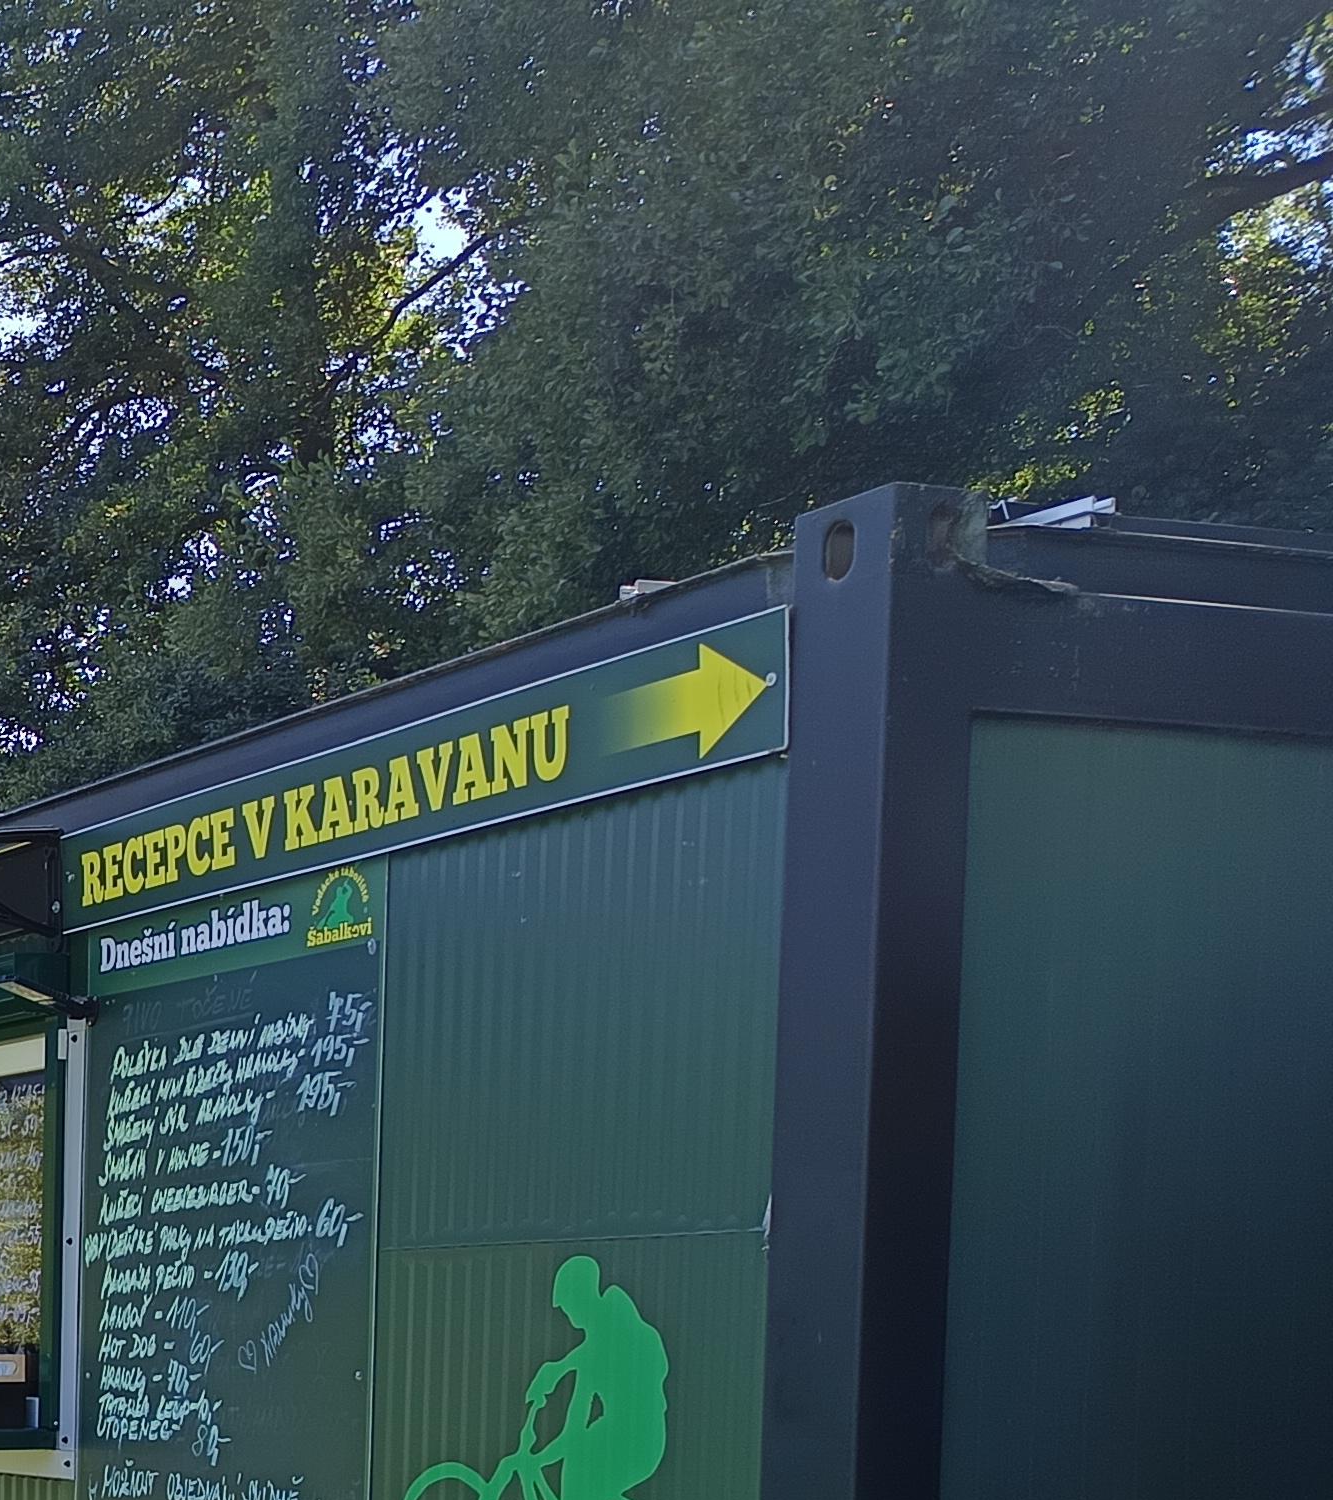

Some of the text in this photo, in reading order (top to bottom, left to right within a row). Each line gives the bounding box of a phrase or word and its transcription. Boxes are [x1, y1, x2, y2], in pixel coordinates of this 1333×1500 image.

[81, 705, 569, 907] RECEPCE V KARAVANU
[100, 900, 291, 972] Dnešní nabídka:
[307, 917, 372, 947] Šabalkovi
[98, 1333, 126, 1362] HOT
